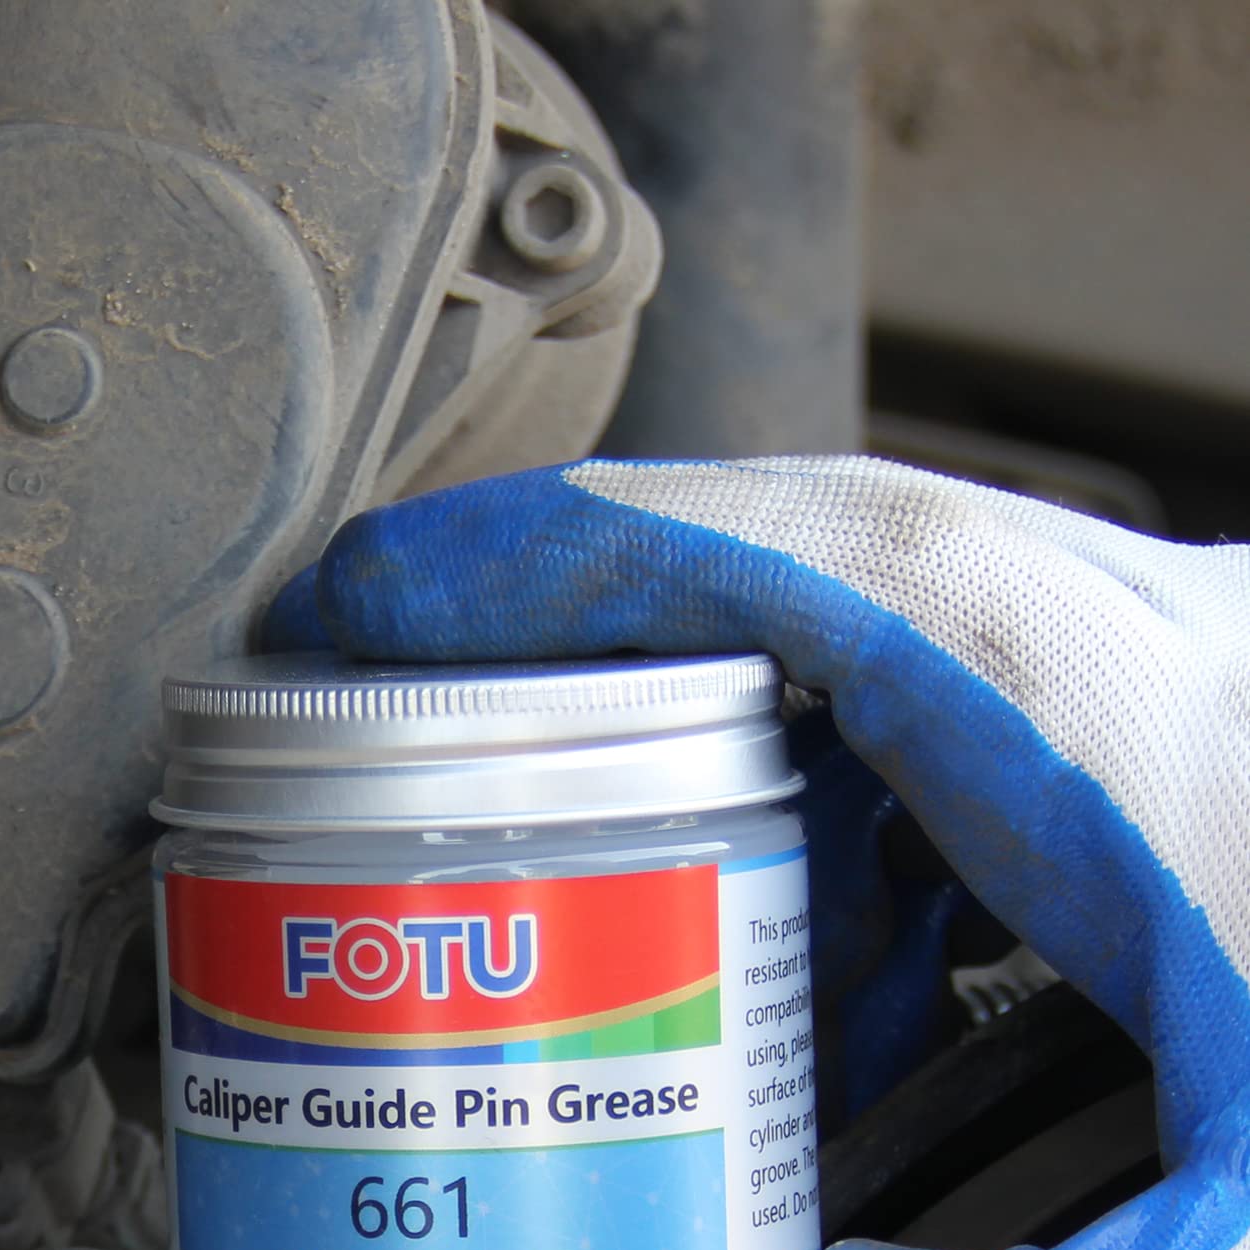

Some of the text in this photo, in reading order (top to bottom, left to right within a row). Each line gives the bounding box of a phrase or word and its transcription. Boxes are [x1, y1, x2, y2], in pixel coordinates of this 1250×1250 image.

[749, 916, 778, 944] This
[282, 914, 538, 1001] FOTU
[745, 952, 798, 986] resistant
[747, 1039, 789, 1068] using,
[184, 1075, 699, 1132] Caliper Guide Pin Grease
[748, 1076, 796, 1108] surface
[798, 1065, 807, 1093] of
[750, 1113, 801, 1154] cylinder
[751, 1158, 801, 1195] groove.
[351, 1176, 468, 1239] 661
[752, 1195, 790, 1228] used.
[794, 1191, 807, 1216] Do
